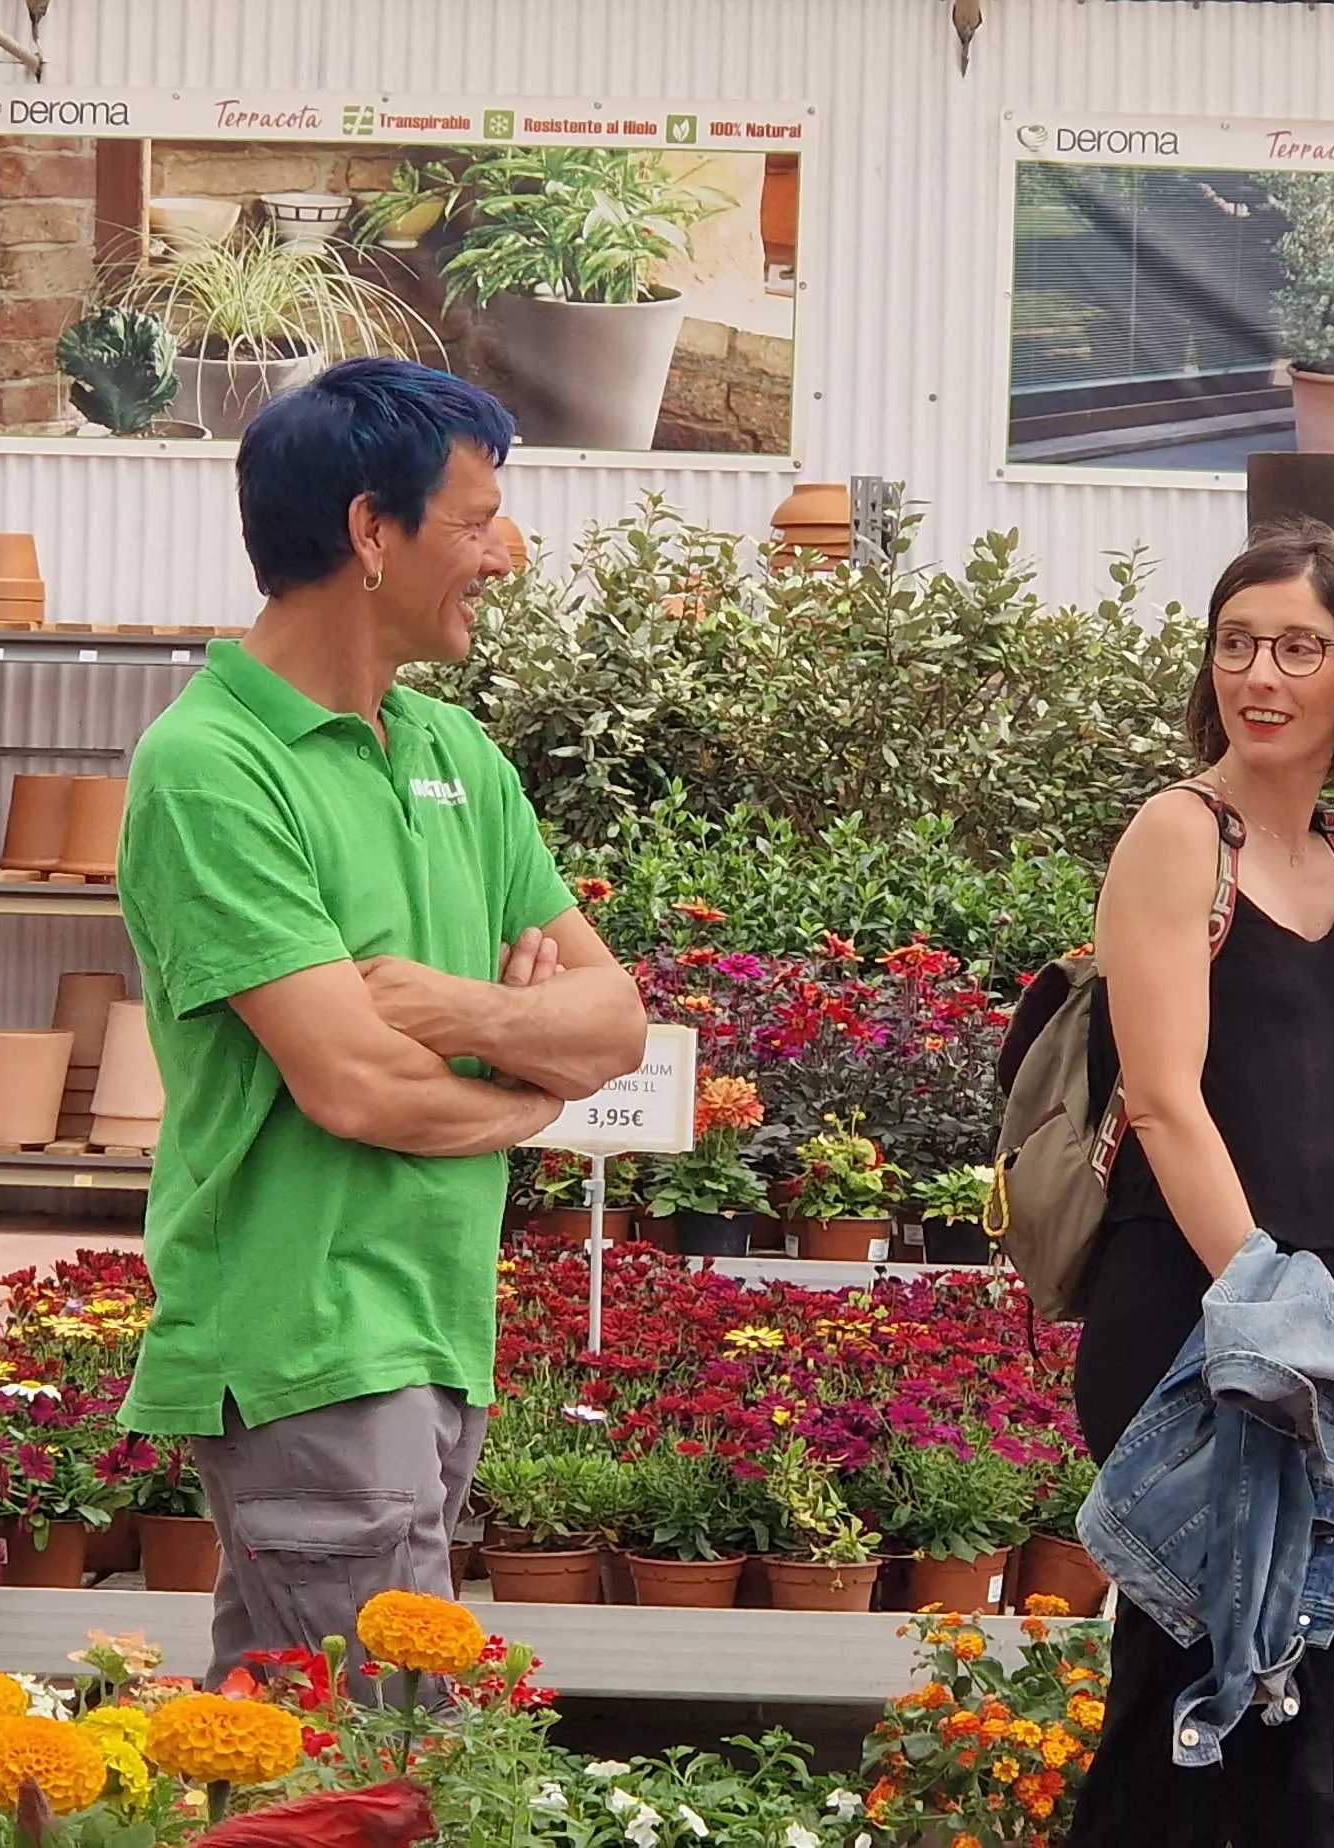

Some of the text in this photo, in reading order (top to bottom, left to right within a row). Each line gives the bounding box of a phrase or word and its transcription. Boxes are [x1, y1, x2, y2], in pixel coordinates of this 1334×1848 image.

[10, 99, 129, 126] Deroma
[215, 99, 322, 129] Terracota
[379, 112, 471, 131] Transpirable
[523, 117, 657, 136] Resistente al Hielo
[709, 121, 802, 139] 100% Natural
[1057, 128, 1179, 155] Deroma
[643, 1081, 656, 1092] 1L
[587, 1107, 644, 1129] 3,95€
